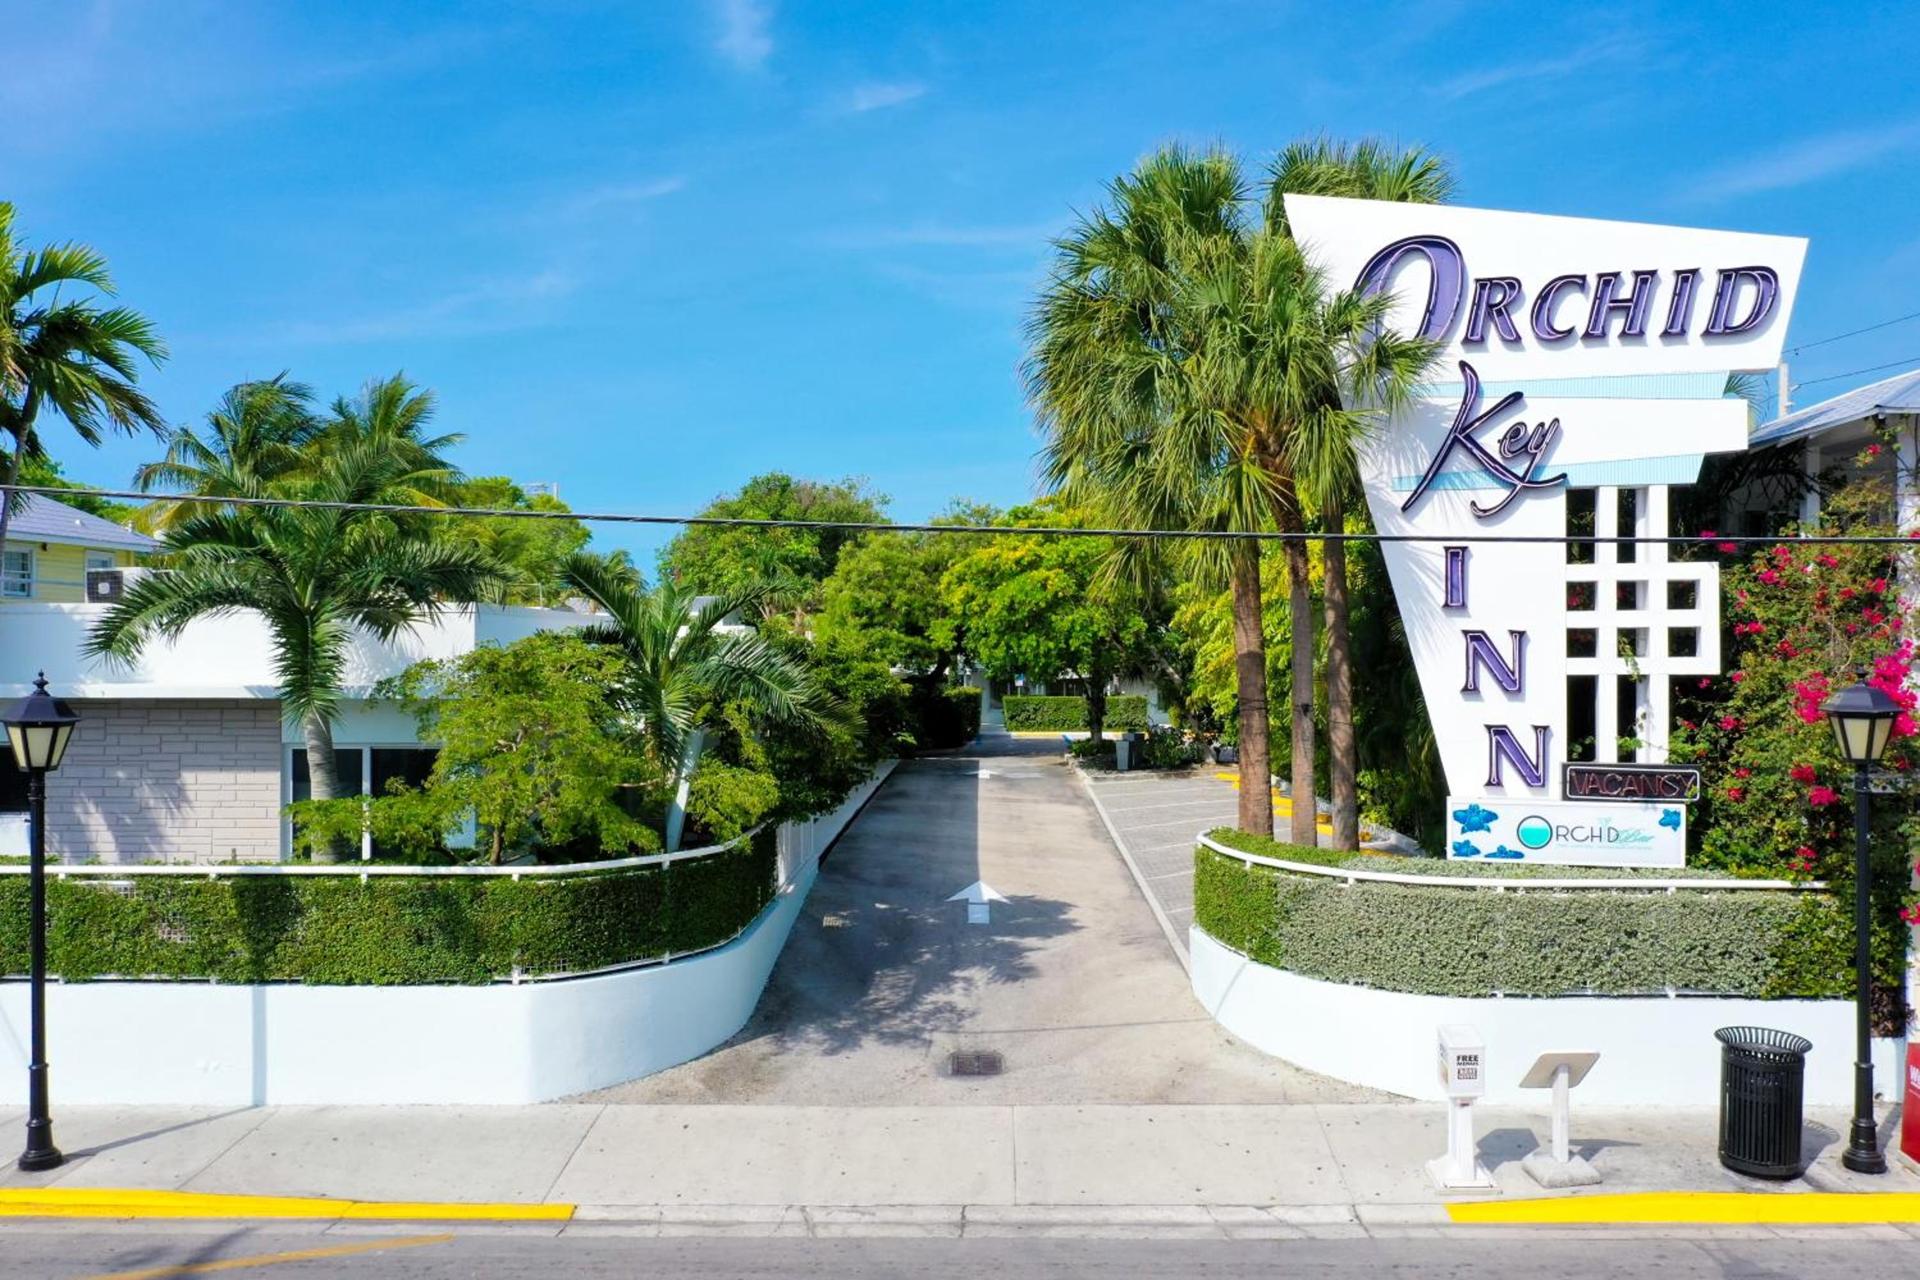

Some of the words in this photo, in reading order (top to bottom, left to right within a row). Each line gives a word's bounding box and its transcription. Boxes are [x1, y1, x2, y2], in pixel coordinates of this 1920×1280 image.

[1347, 235, 1780, 346] ORCHID
[1402, 361, 1567, 518] Key
[1442, 546, 1550, 787] INN
[1571, 772, 1696, 797] VACANCY
[1456, 1054, 1479, 1062] FREE
